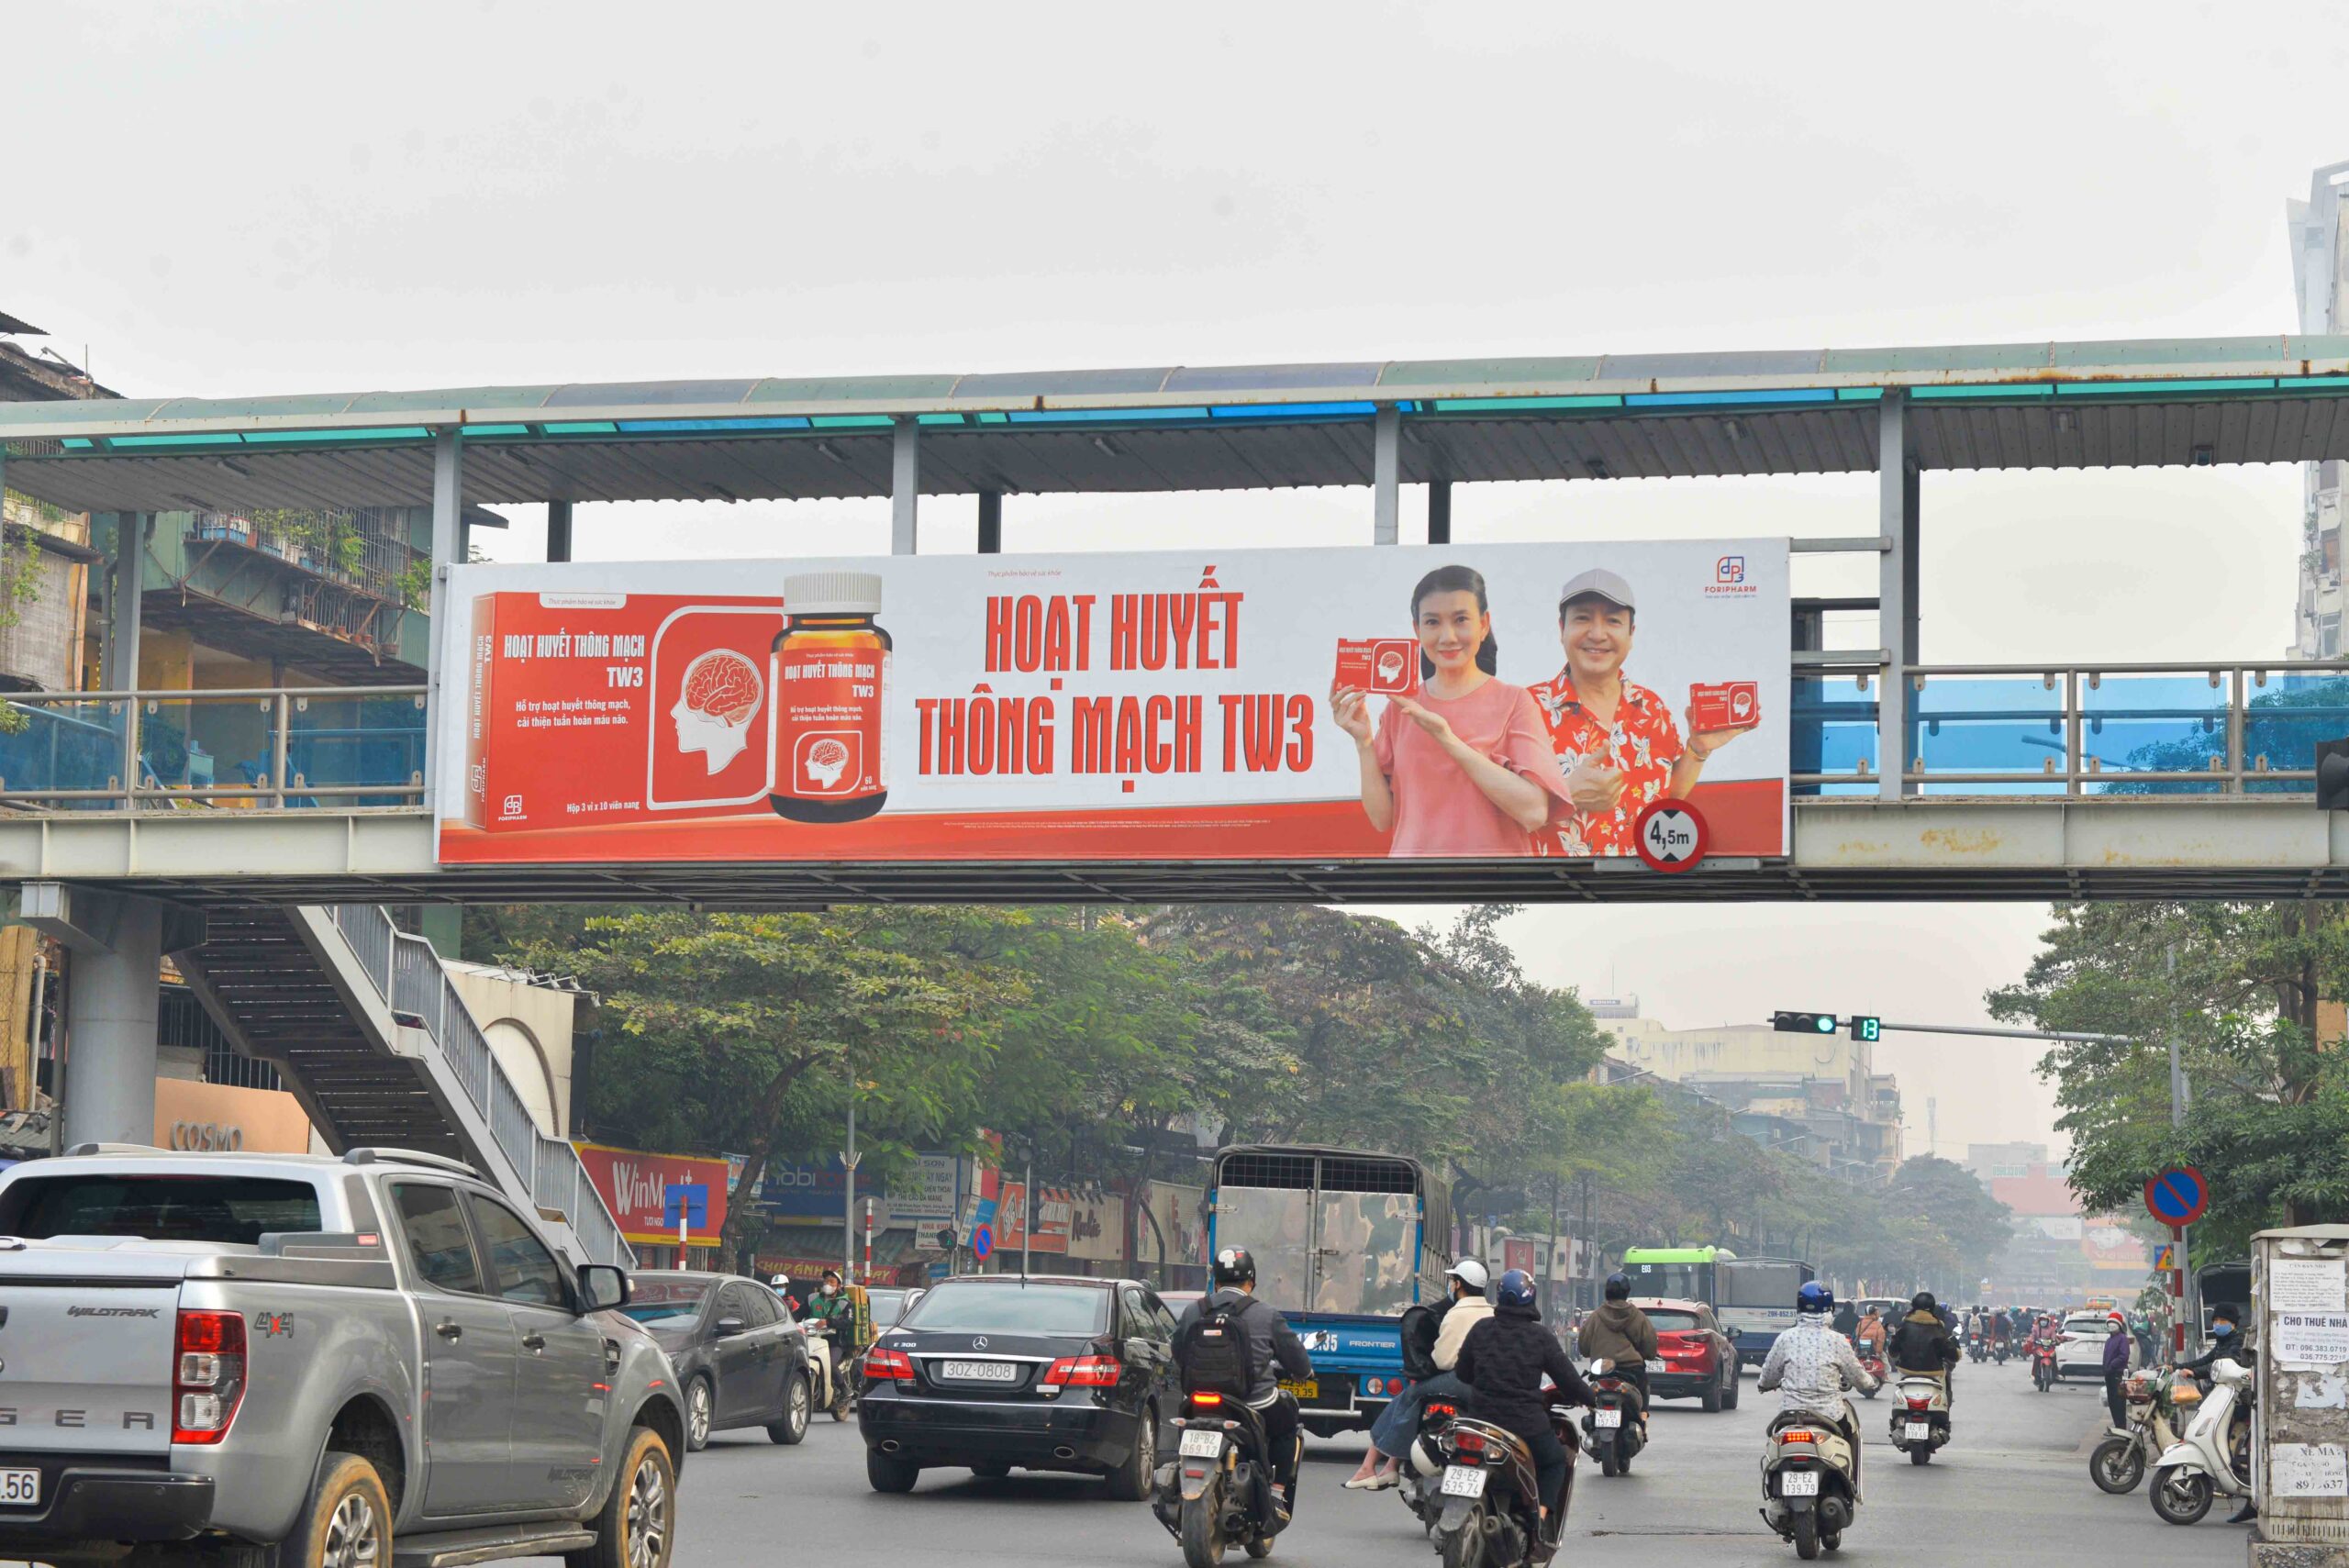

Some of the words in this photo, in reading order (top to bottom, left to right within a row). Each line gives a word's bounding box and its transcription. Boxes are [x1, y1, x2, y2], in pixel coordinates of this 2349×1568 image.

[1704, 585, 1757, 594] FORIPHARM
[985, 594, 1096, 691] HOẠT
[1110, 565, 1244, 672] HUYẾT
[504, 635, 534, 663] HOẠT
[537, 627, 572, 658] HUYẾT
[574, 631, 609, 658] THÔNG
[613, 635, 645, 662] MẠCH
[607, 666, 644, 688] TW3
[803, 660, 826, 679] HUYẾT
[828, 662, 853, 678] THÔNG
[852, 684, 874, 697] TW3
[516, 699, 527, 712] Hỗ
[529, 702, 541, 712] trợ
[542, 700, 560, 712] hoạt
[562, 697, 584, 712] huyết
[584, 699, 607, 712] thông
[517, 717, 529, 728] cải
[531, 716, 551, 728] thiện
[553, 714, 572, 726] tuần
[573, 716, 592, 726] hoàn
[594, 715, 610, 726] máu
[916, 683, 1055, 775] THÔNG
[1072, 694, 1203, 793] MẠCH
[1219, 694, 1314, 773] TW3
[864, 776, 873, 784] 60
[566, 804, 580, 814] Hộp
[581, 803, 587, 812] 3
[599, 802, 607, 811] 10
[609, 802, 623, 810] viên
[624, 802, 640, 810] nang
[1650, 820, 1689, 851] 4,5m
[1863, 1019, 1878, 1040] 13
[170, 1119, 243, 1152] COSMO
[1642, 1264, 1652, 1273] E03
[67, 1306, 161, 1319] WILDTRAK
[253, 1312, 295, 1339] 4x4
[2284, 1316, 2302, 1326] CHO
[2304, 1317, 2327, 1327] THUÊ
[1349, 1340, 1396, 1349] FRONTIER
[1451, 1468, 1479, 1483] 29-E2
[1788, 1473, 1812, 1484] 29-E2
[1444, 1480, 1478, 1496] 535.74
